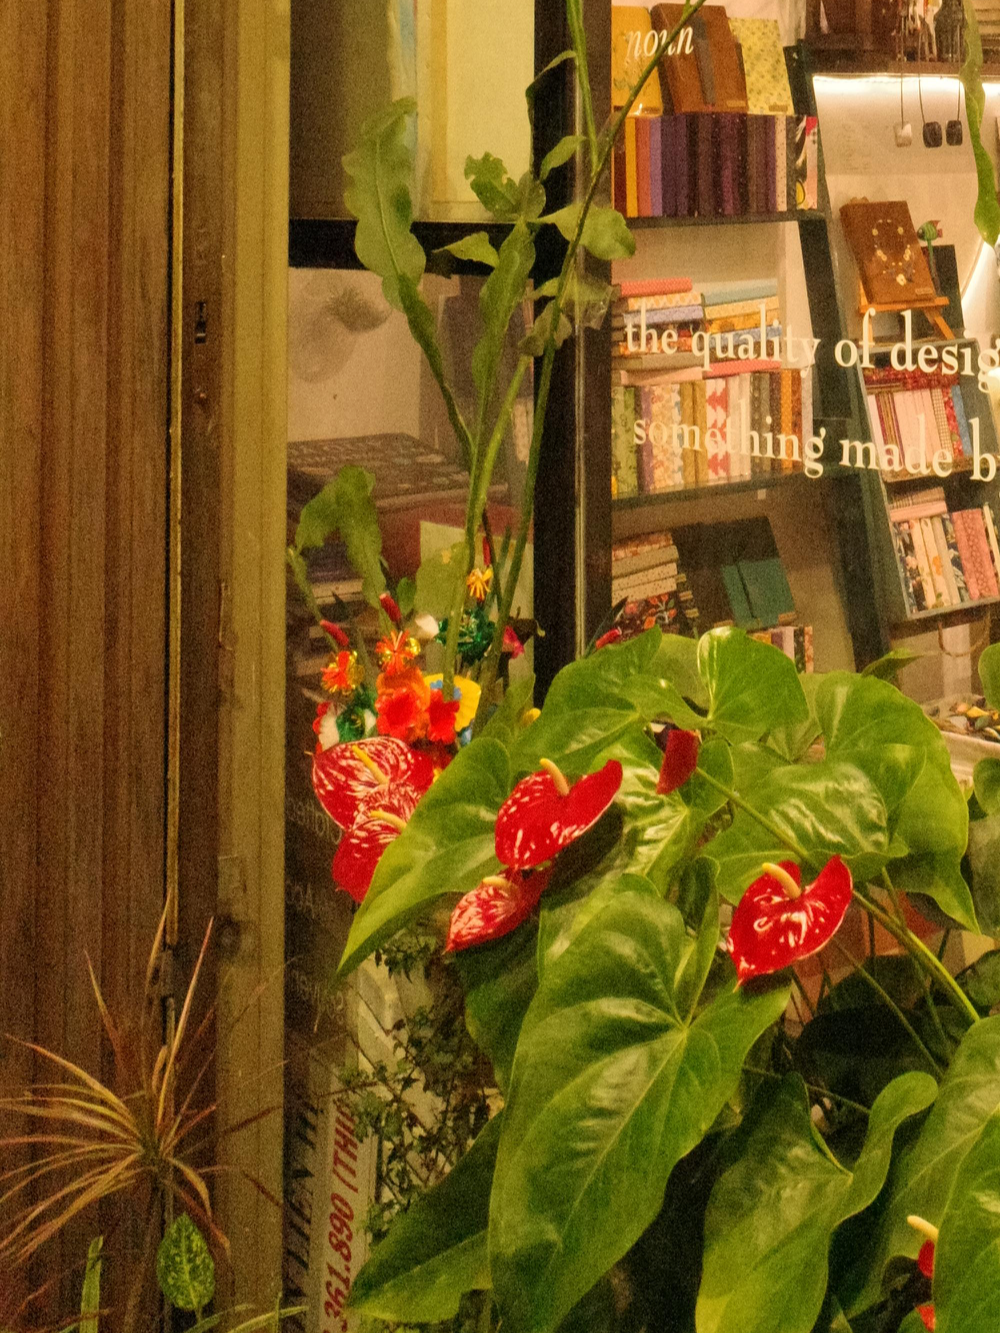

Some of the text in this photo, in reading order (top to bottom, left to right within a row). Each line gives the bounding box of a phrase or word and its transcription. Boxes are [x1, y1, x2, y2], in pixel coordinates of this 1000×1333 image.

[624, 301, 679, 357] the
[691, 303, 822, 378] quality
[834, 308, 878, 369] of
[632, 395, 827, 479] something
[838, 412, 954, 479] made
